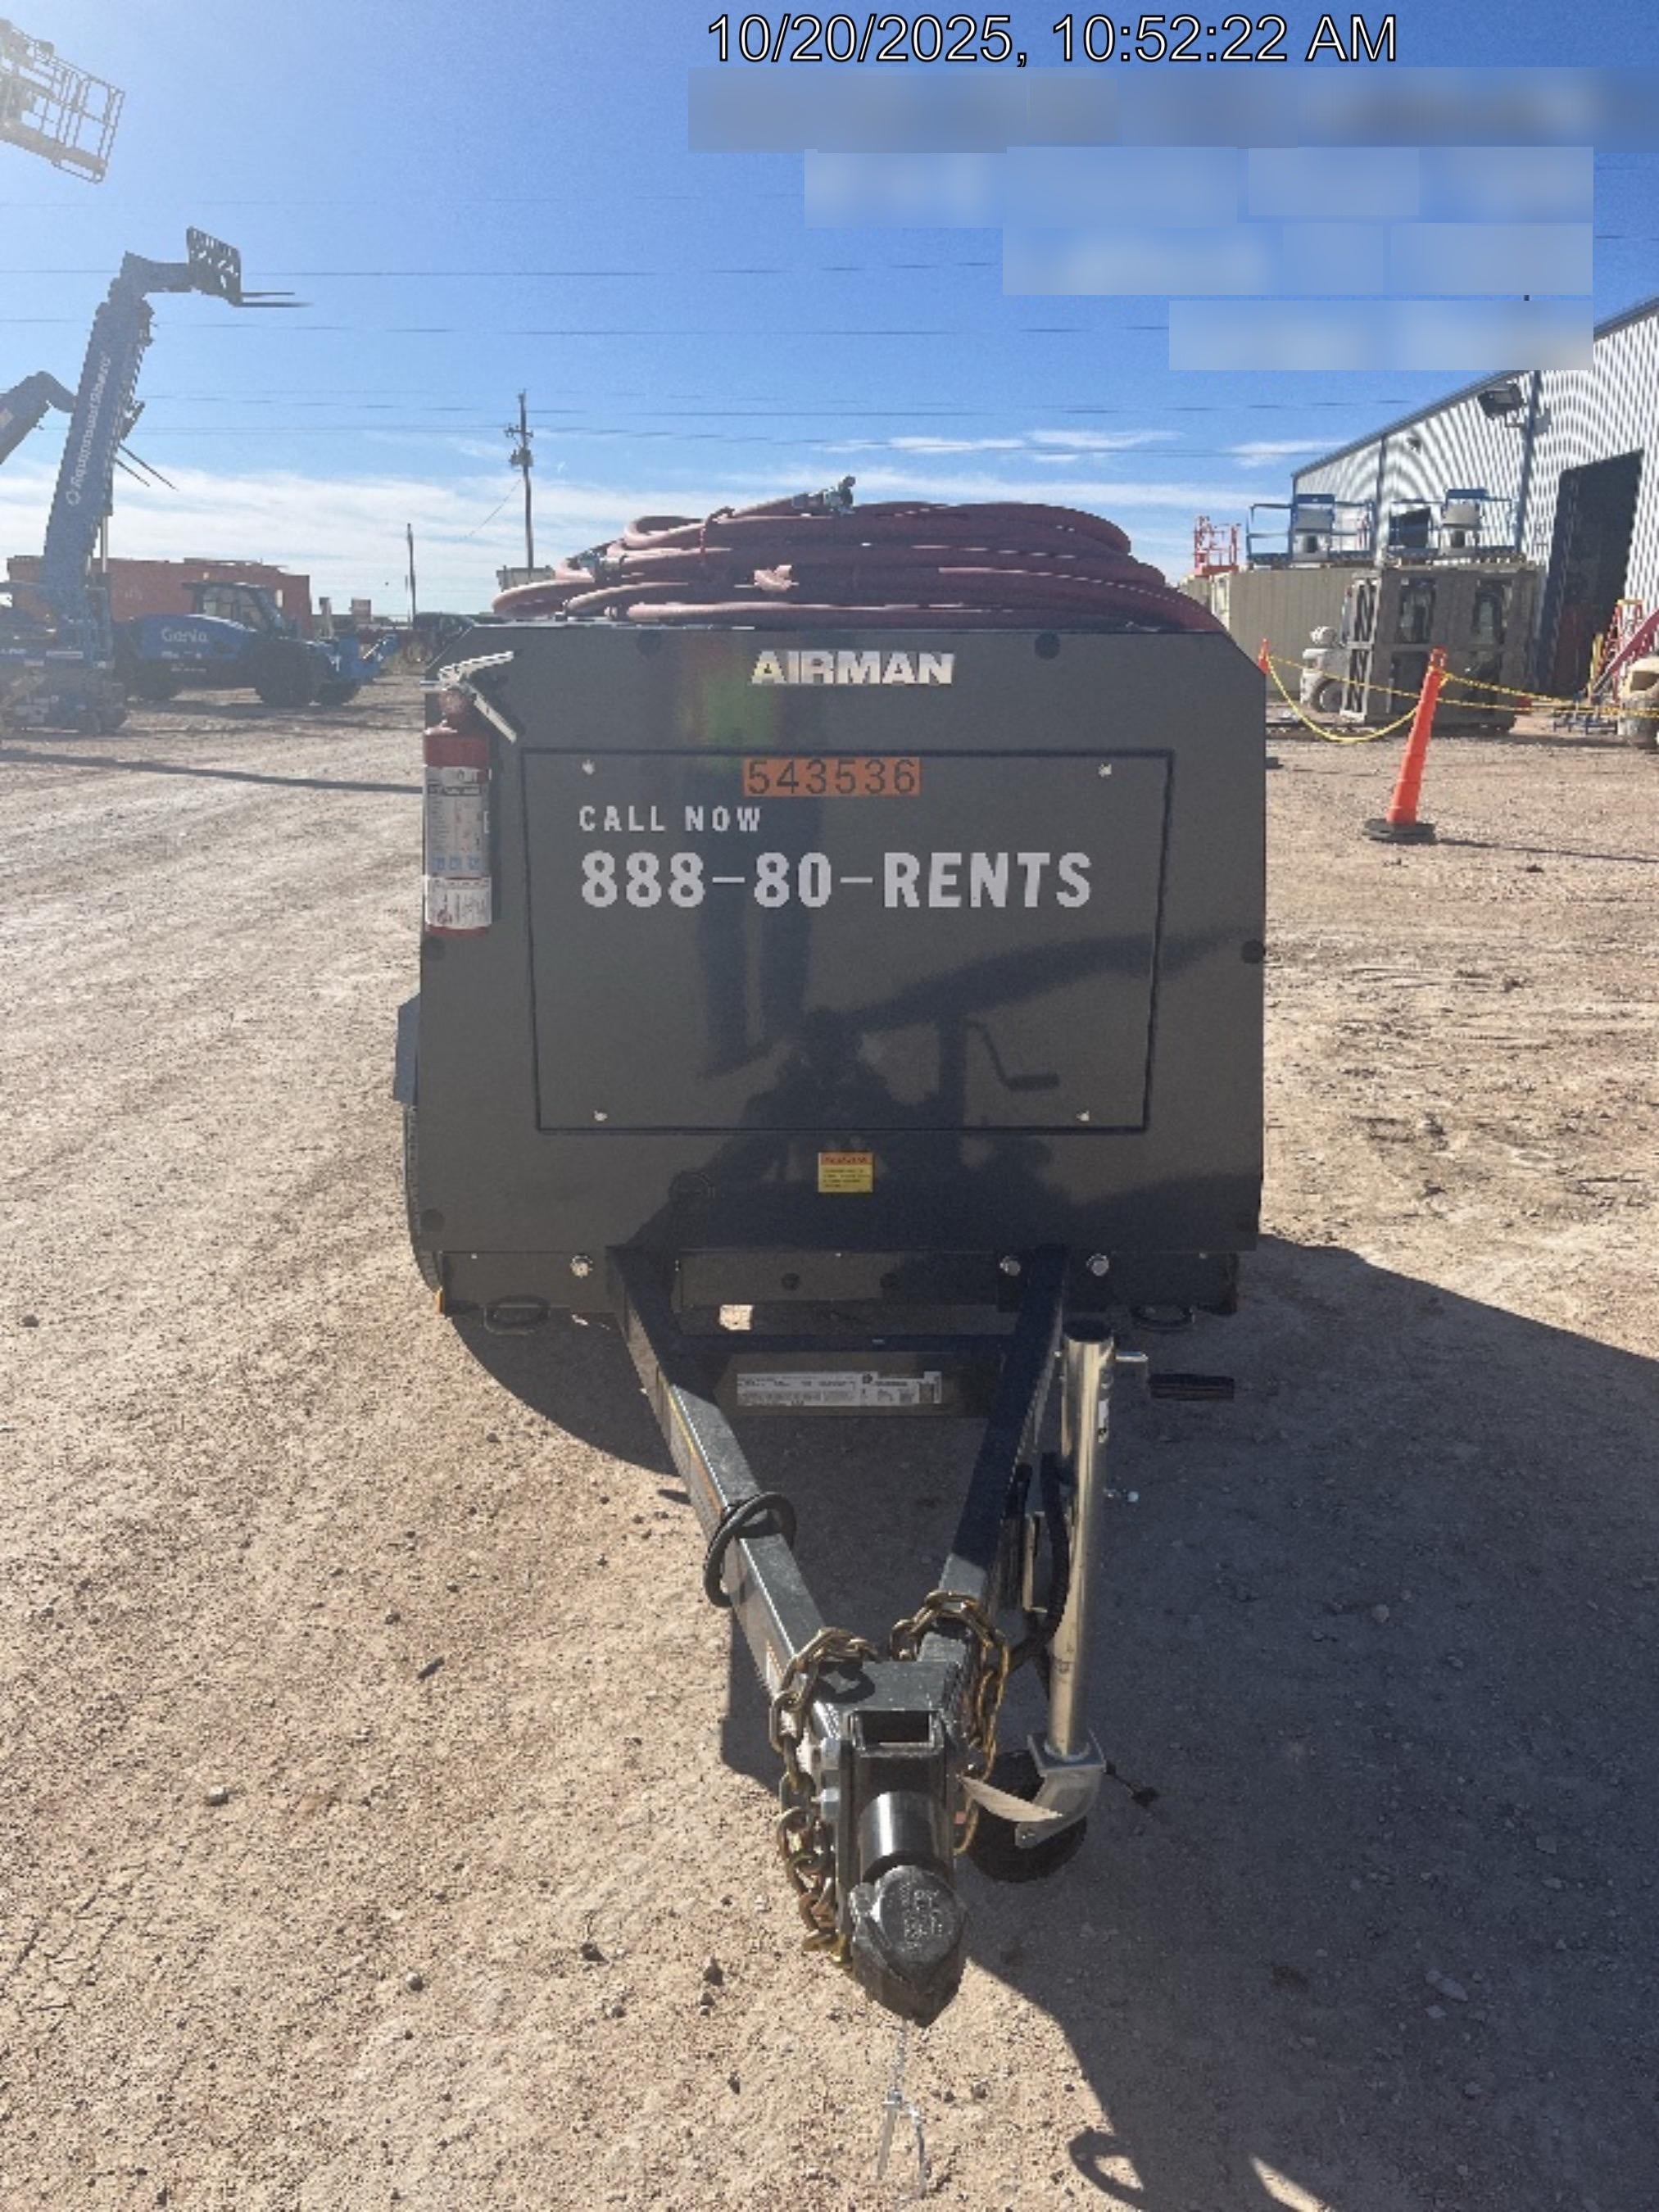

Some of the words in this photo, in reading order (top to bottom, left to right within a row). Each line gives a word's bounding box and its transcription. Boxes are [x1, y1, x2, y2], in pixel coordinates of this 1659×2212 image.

[751, 650, 955, 685] AIRMAN
[749, 759, 916, 795] 543536
[578, 805, 666, 832] CALL
[684, 805, 762, 832] NOW
[581, 849, 1093, 909] 888-80-RENTS
